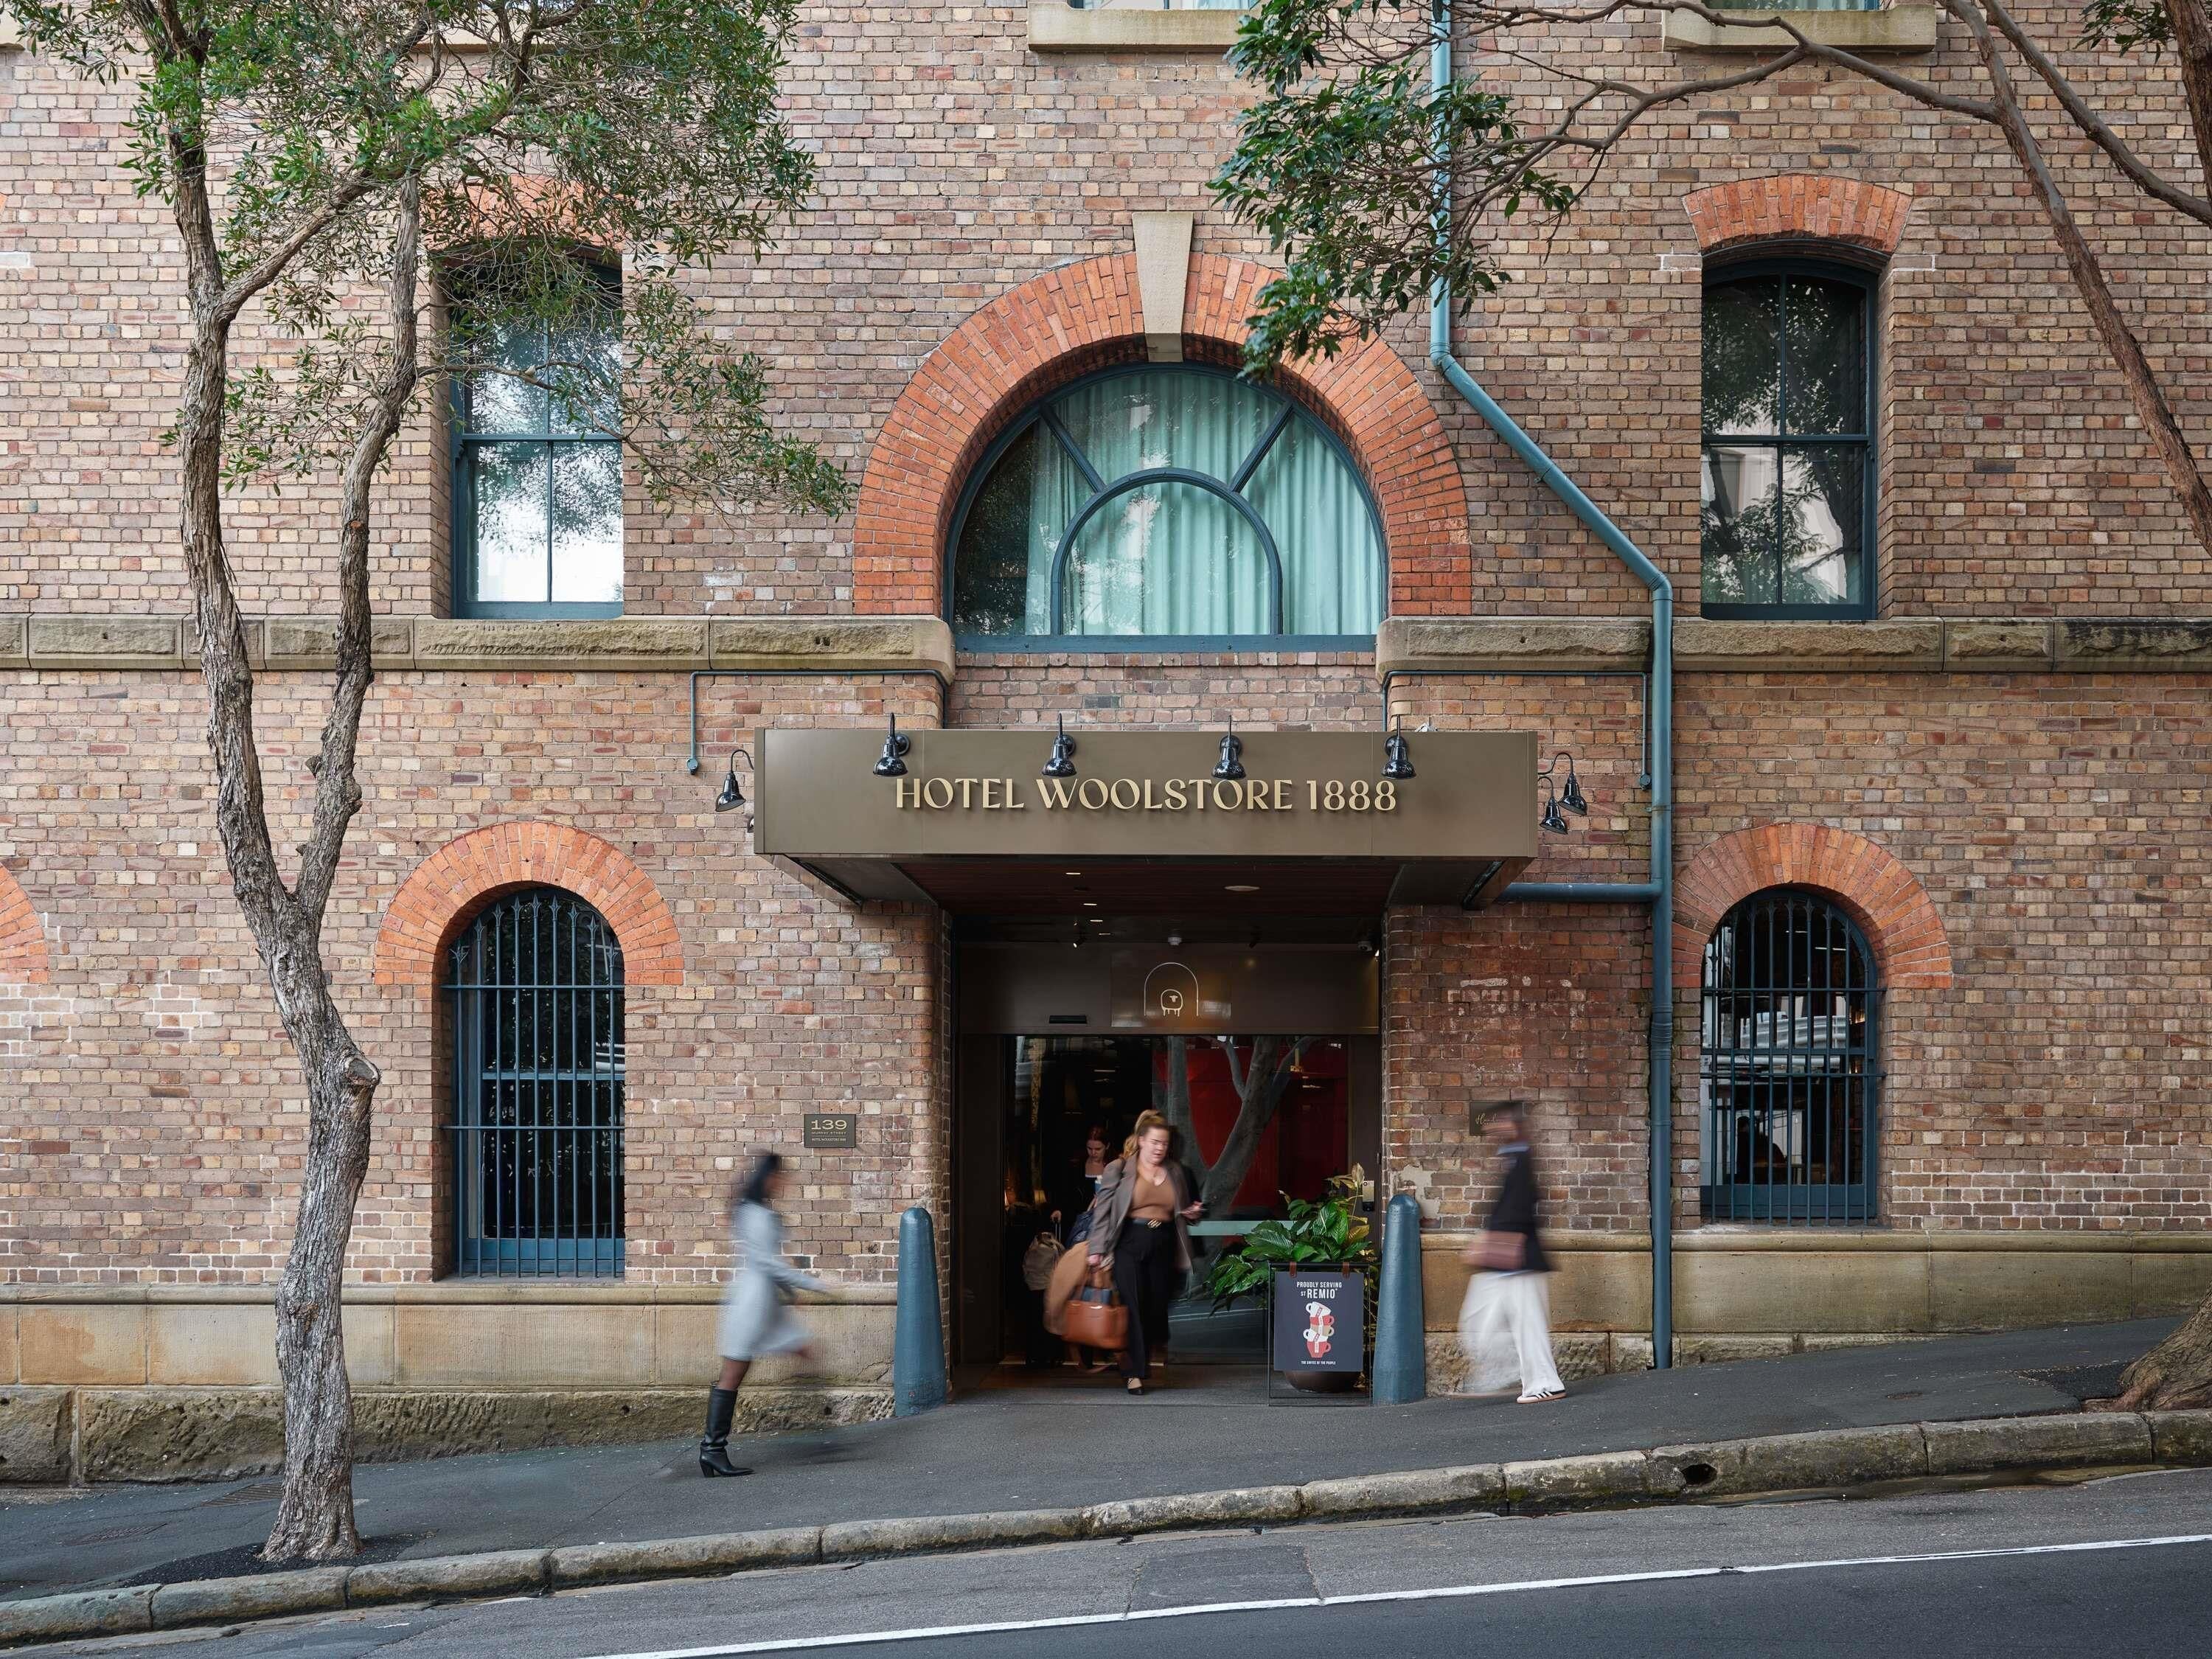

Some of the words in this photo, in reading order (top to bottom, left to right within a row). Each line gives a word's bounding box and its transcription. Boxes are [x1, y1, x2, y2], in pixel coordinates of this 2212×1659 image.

[896, 777, 1025, 809] HOTEL
[1035, 778, 1293, 810] WOOLSTORE
[1306, 779, 1397, 811] 1888
[811, 1119, 847, 1130] 139
[1307, 1288, 1335, 1299] REMIO
